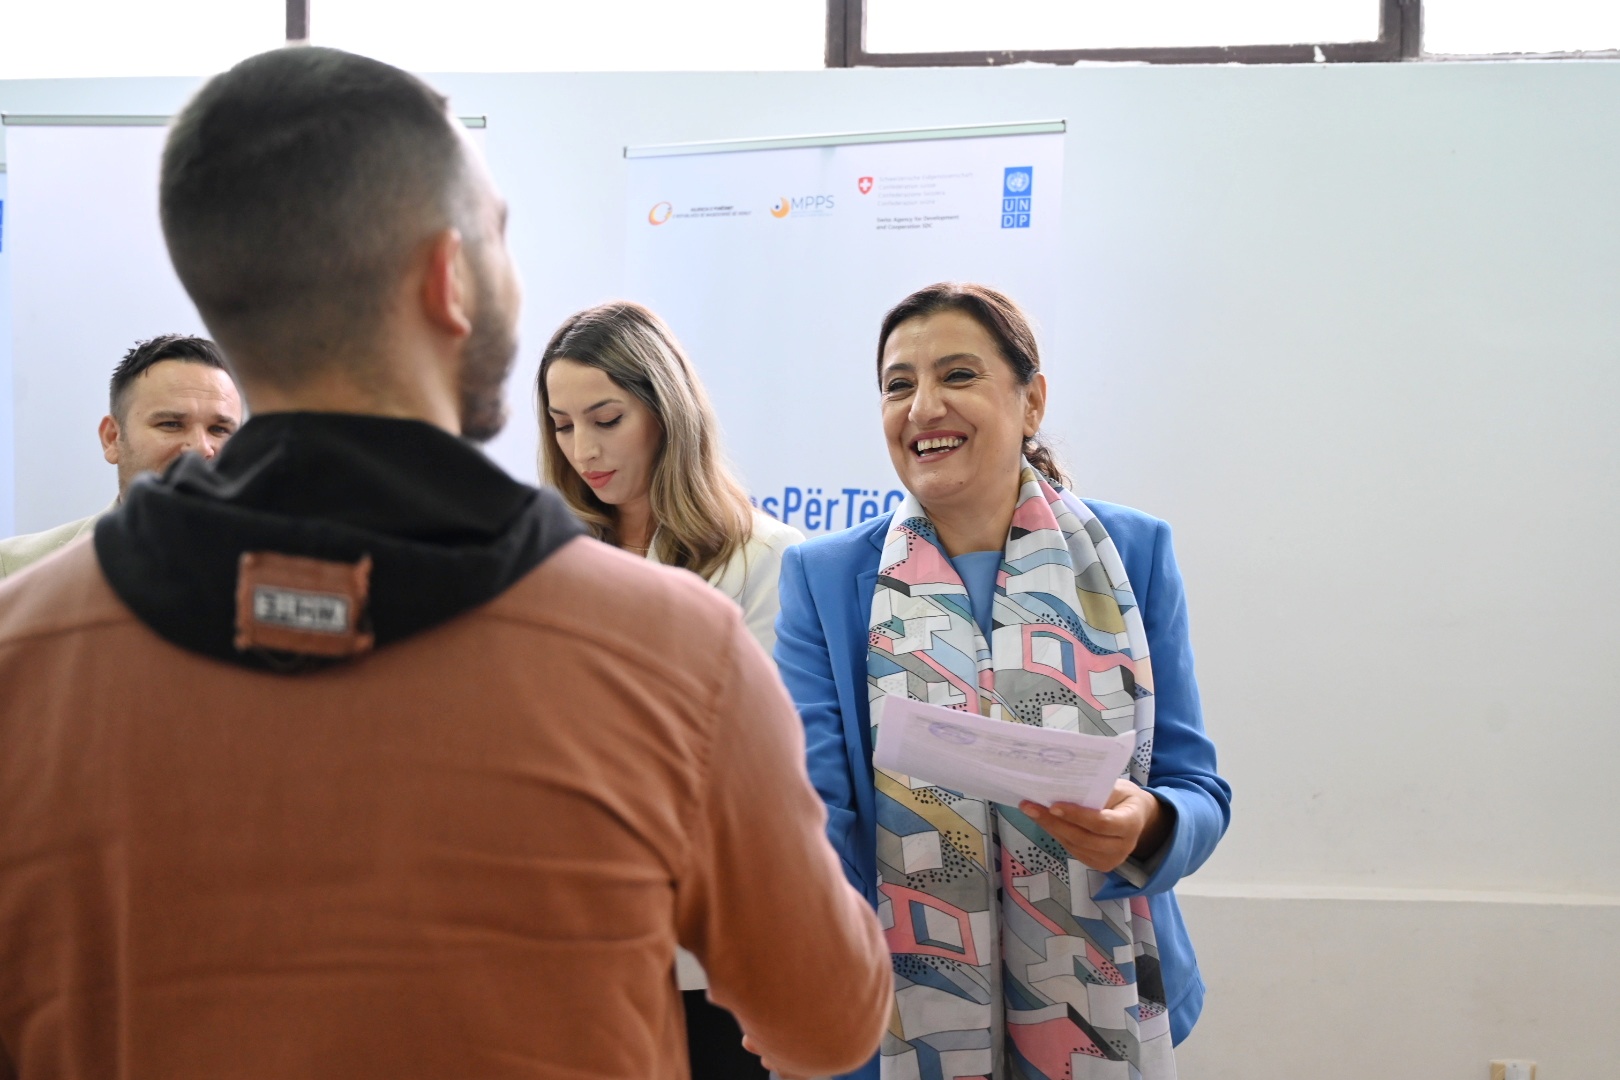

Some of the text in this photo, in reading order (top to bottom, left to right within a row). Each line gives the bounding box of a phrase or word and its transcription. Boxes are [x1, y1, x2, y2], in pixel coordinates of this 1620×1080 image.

[791, 195, 835, 210] MPPS
[1005, 198, 1029, 212] UN
[893, 216, 912, 224] Agency
[923, 213, 960, 222] Development
[1004, 214, 1028, 228] DP
[888, 222, 921, 231] Cooperation
